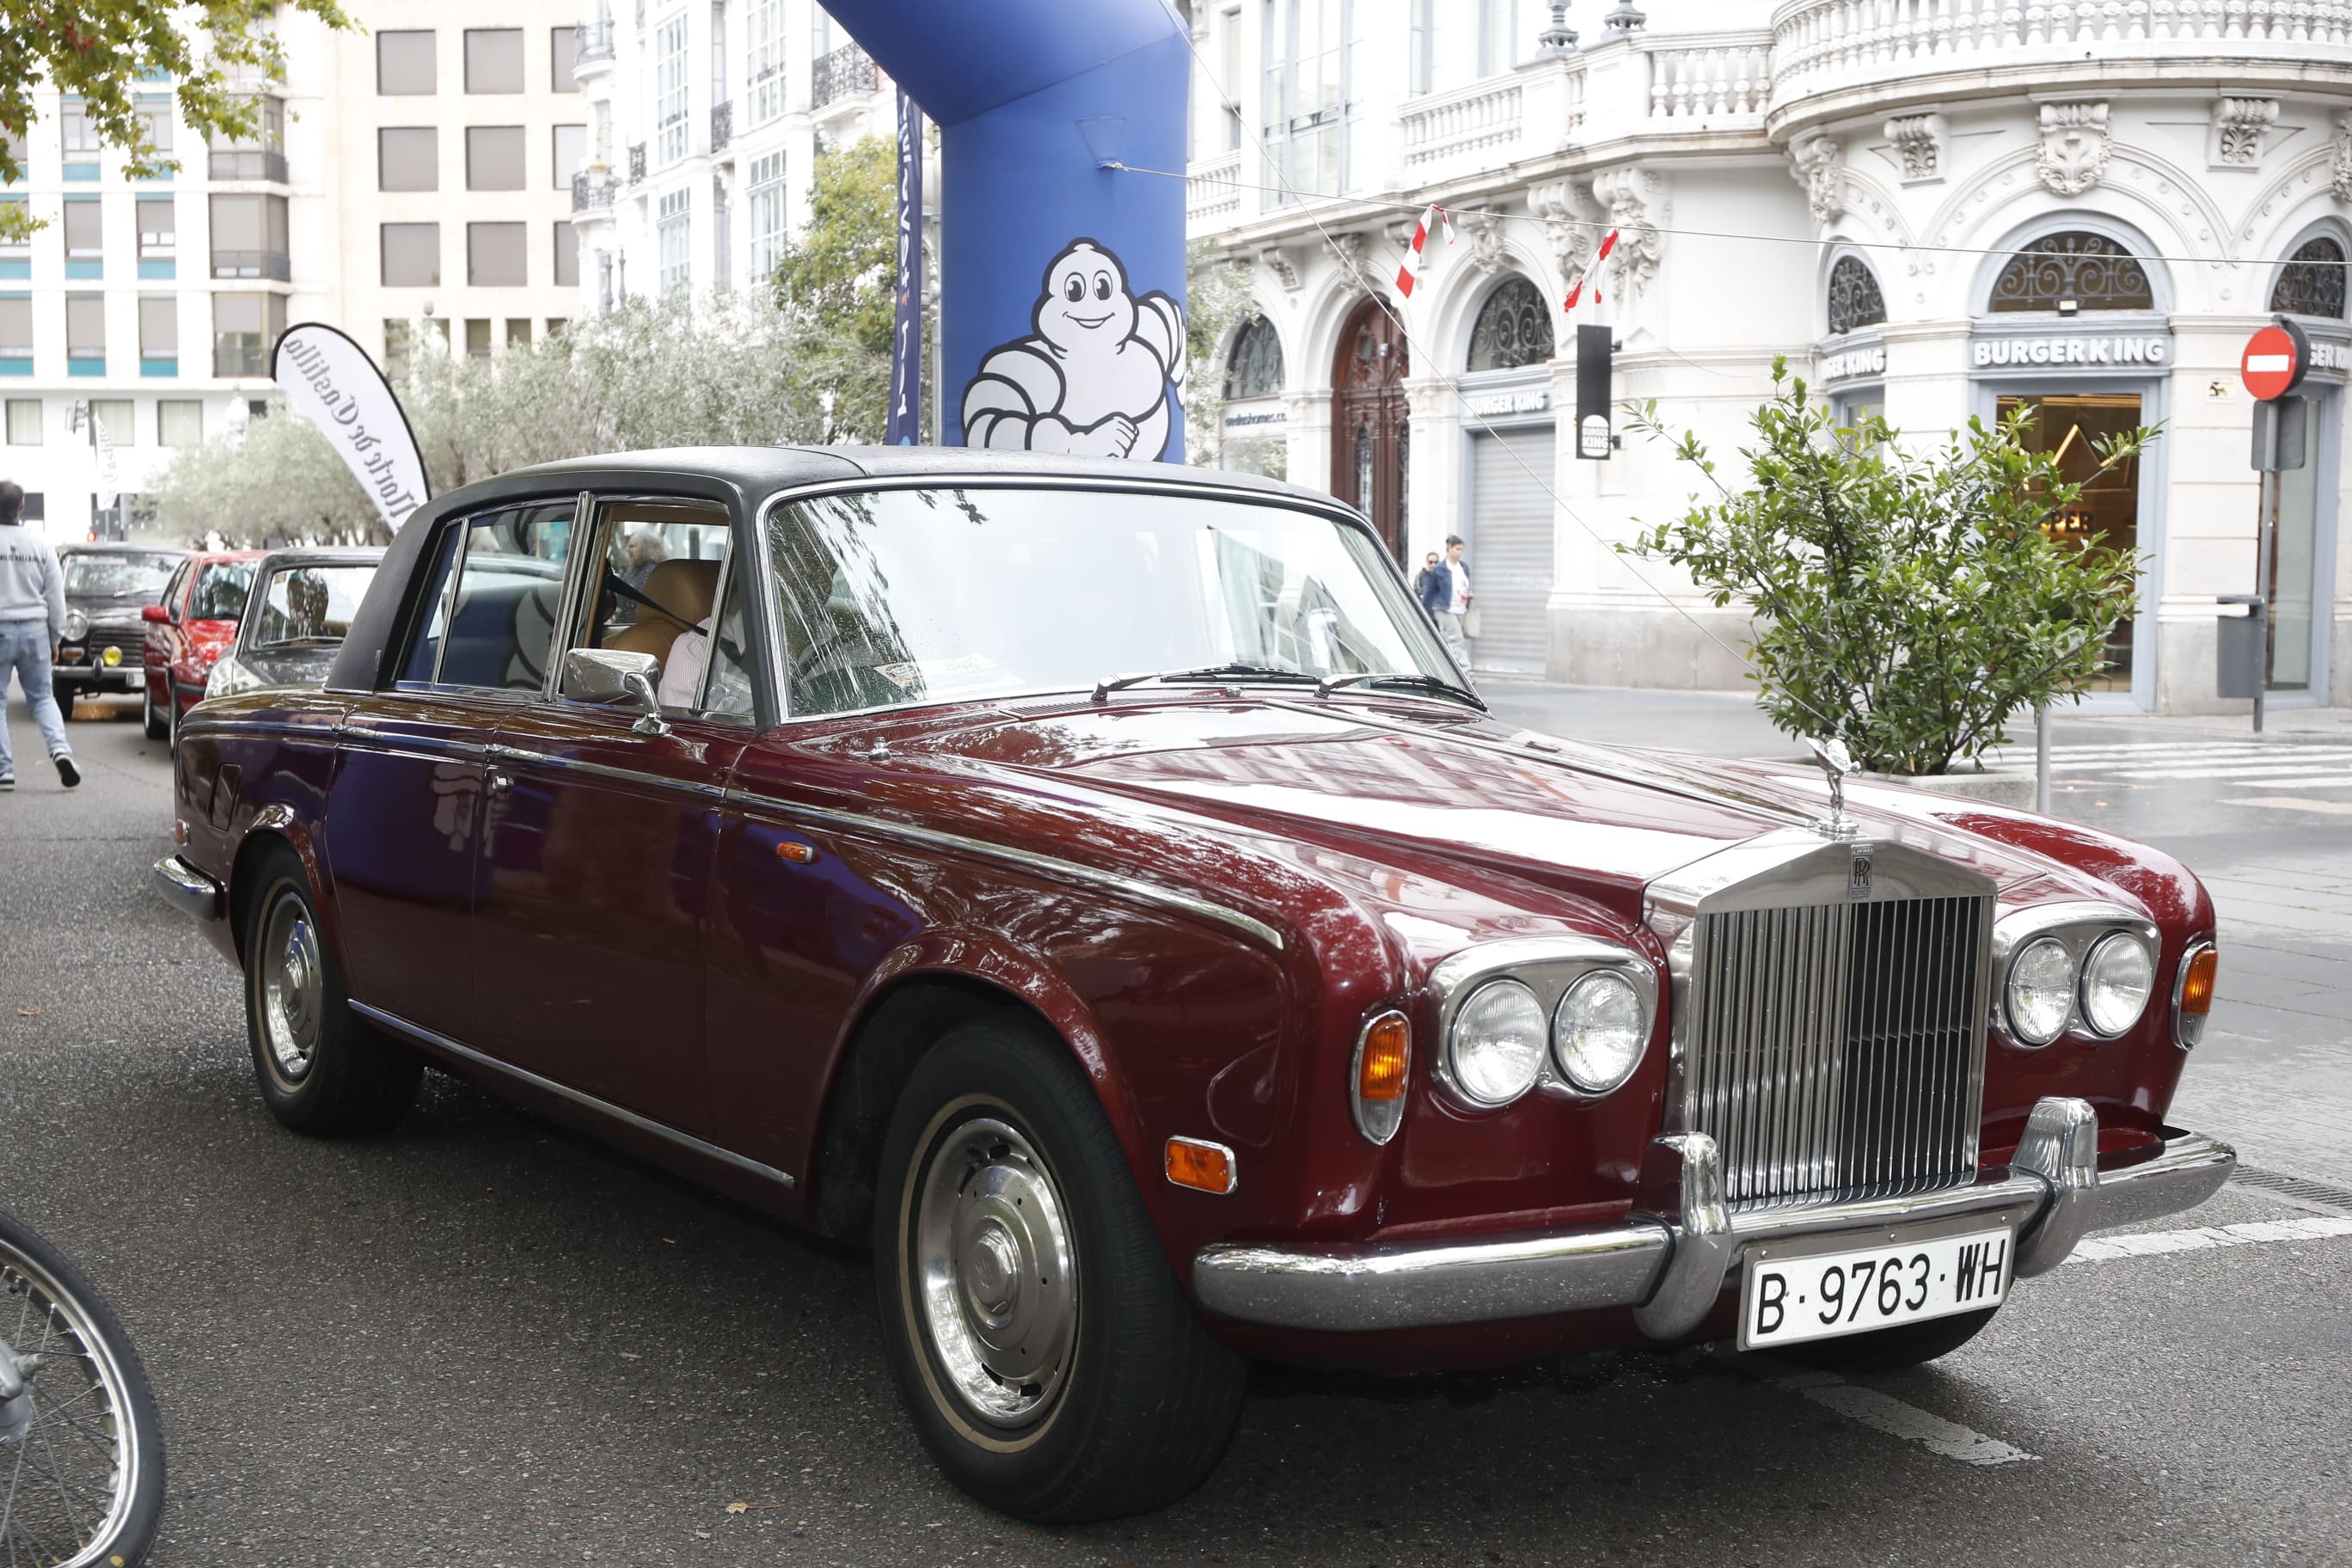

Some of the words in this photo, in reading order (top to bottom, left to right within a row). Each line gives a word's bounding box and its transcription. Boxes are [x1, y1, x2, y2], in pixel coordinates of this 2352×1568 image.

[1846, 349, 1885, 375] KING
[1973, 339, 2085, 365] BURGER
[1514, 390, 1544, 411] KING
[1582, 436, 1608, 449] KING
